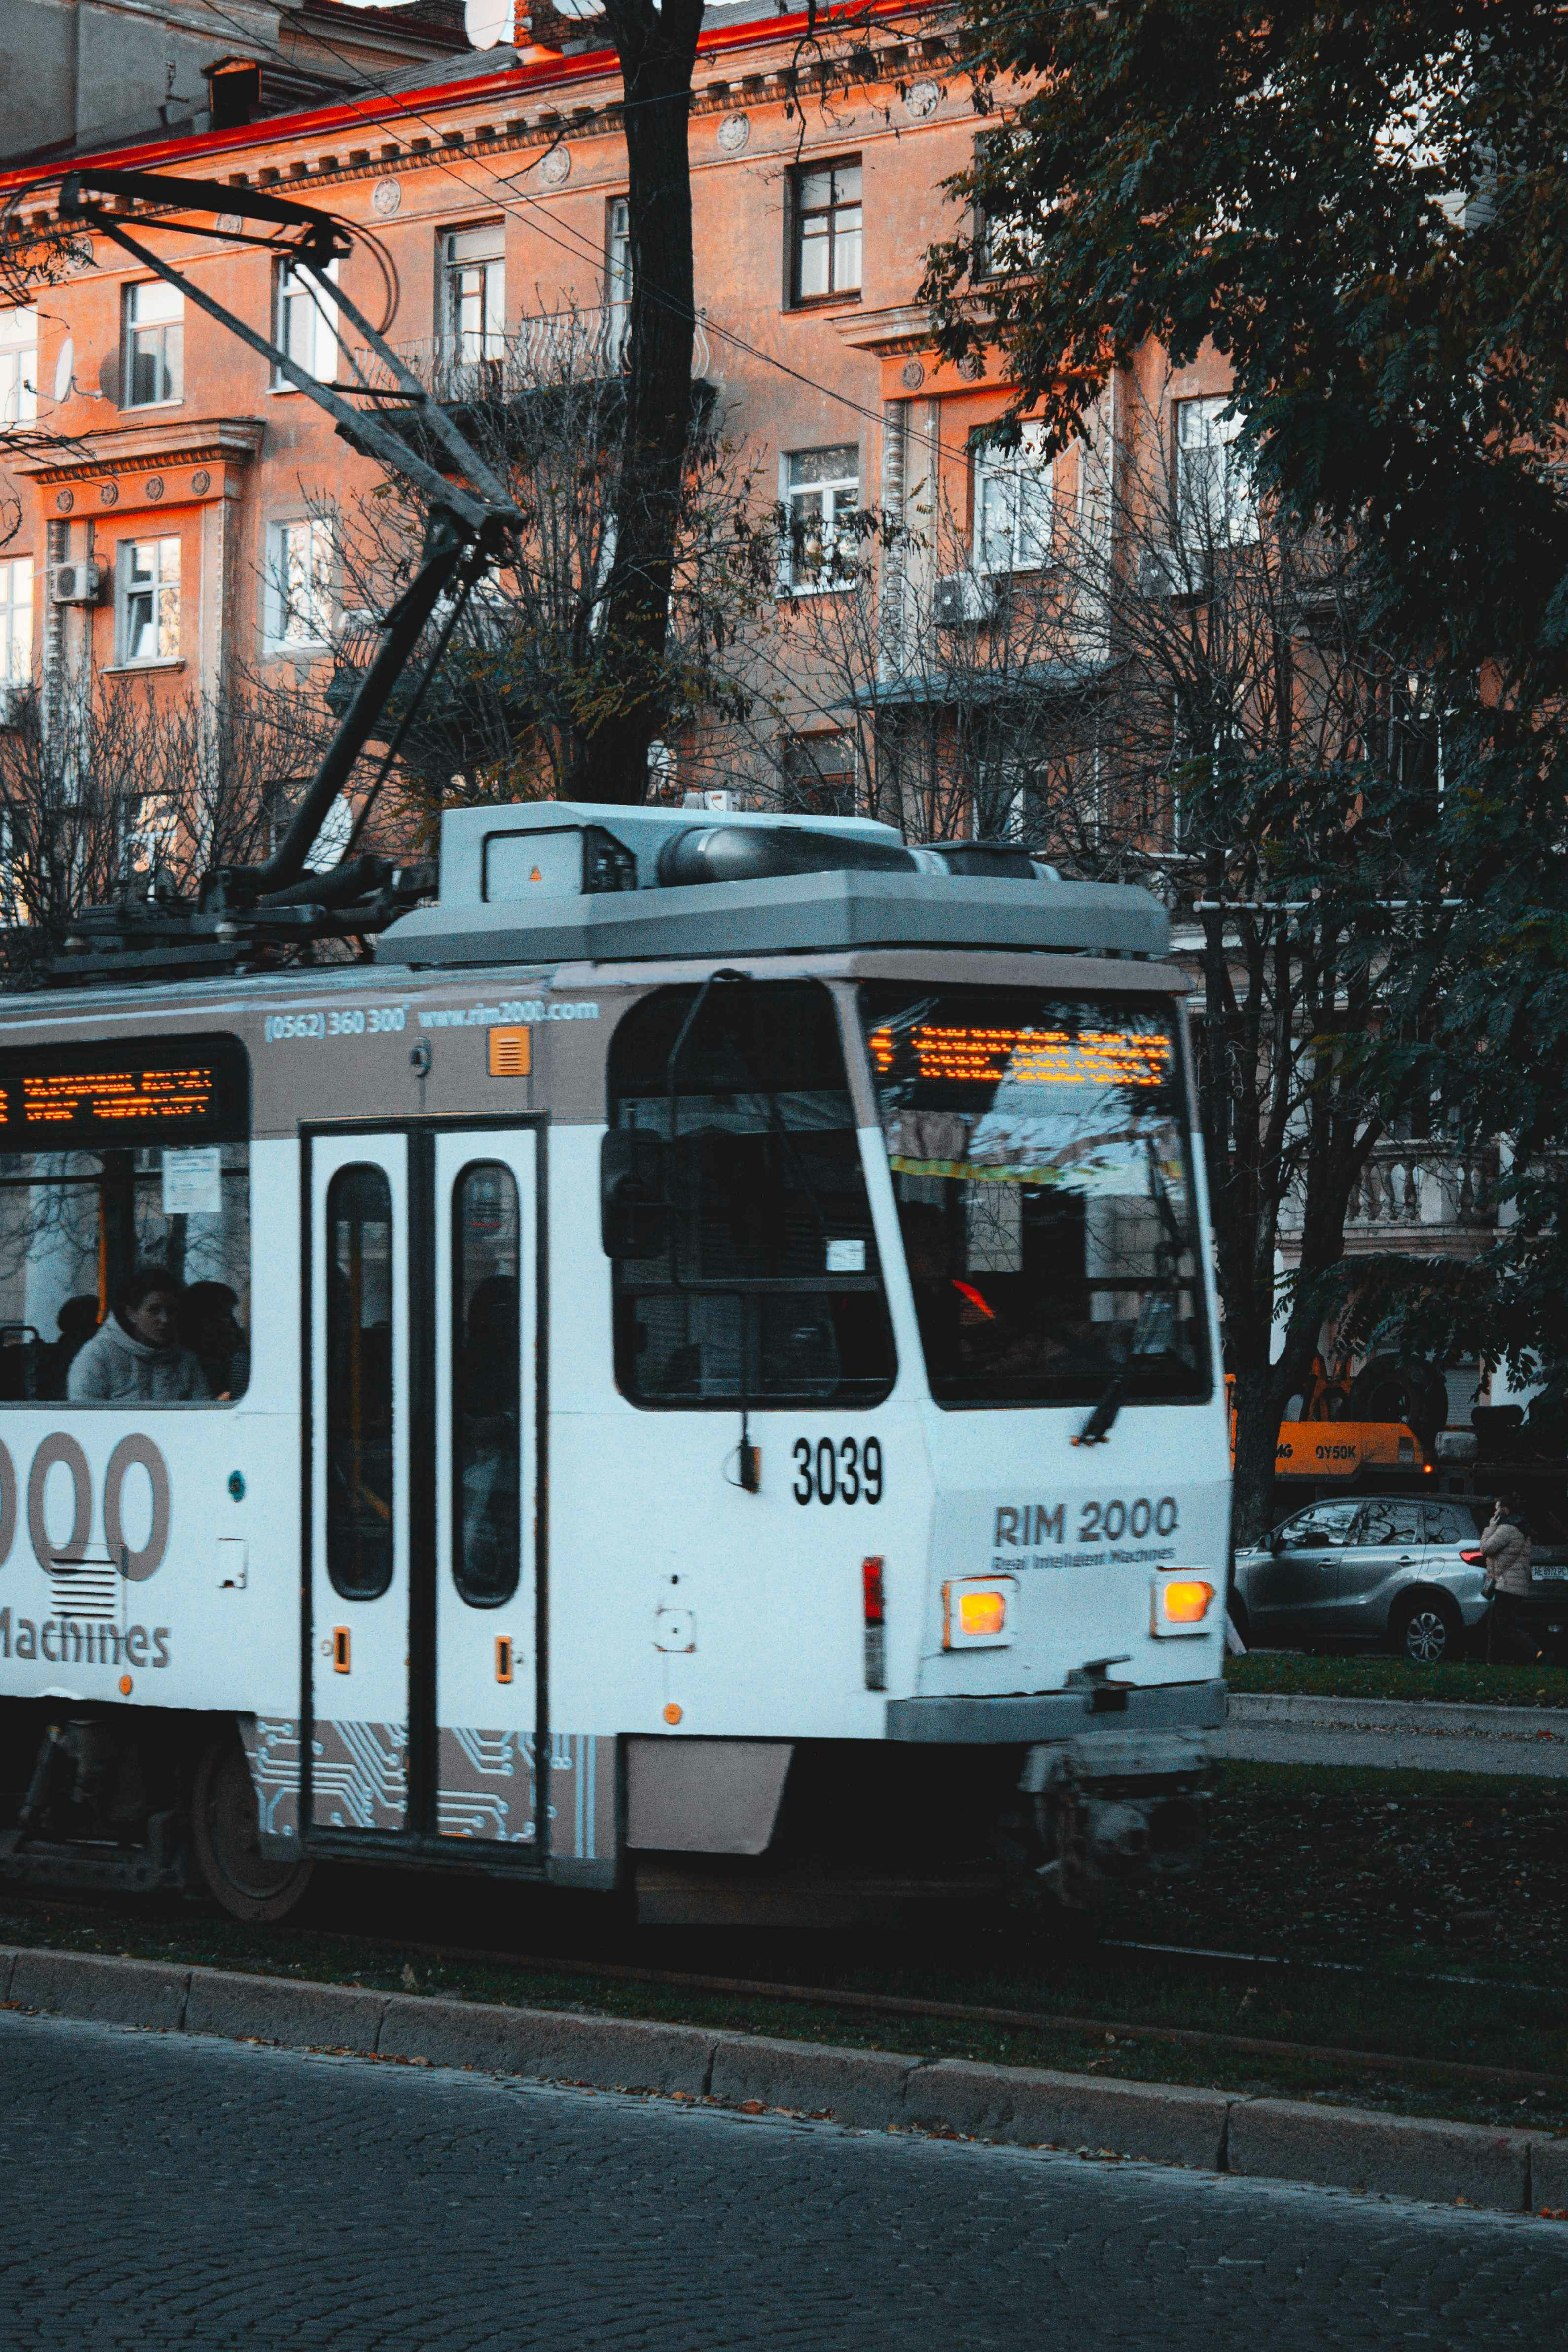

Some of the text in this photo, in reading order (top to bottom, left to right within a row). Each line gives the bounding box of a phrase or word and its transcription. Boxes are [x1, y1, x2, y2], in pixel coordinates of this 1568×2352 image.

[367, 1007, 406, 1033] 300
[793, 1436, 881, 1505] 3039
[1315, 1445, 1357, 1460] QY50K
[0, 1431, 171, 1582] 00
[993, 1496, 1179, 1547] RIM 2000
